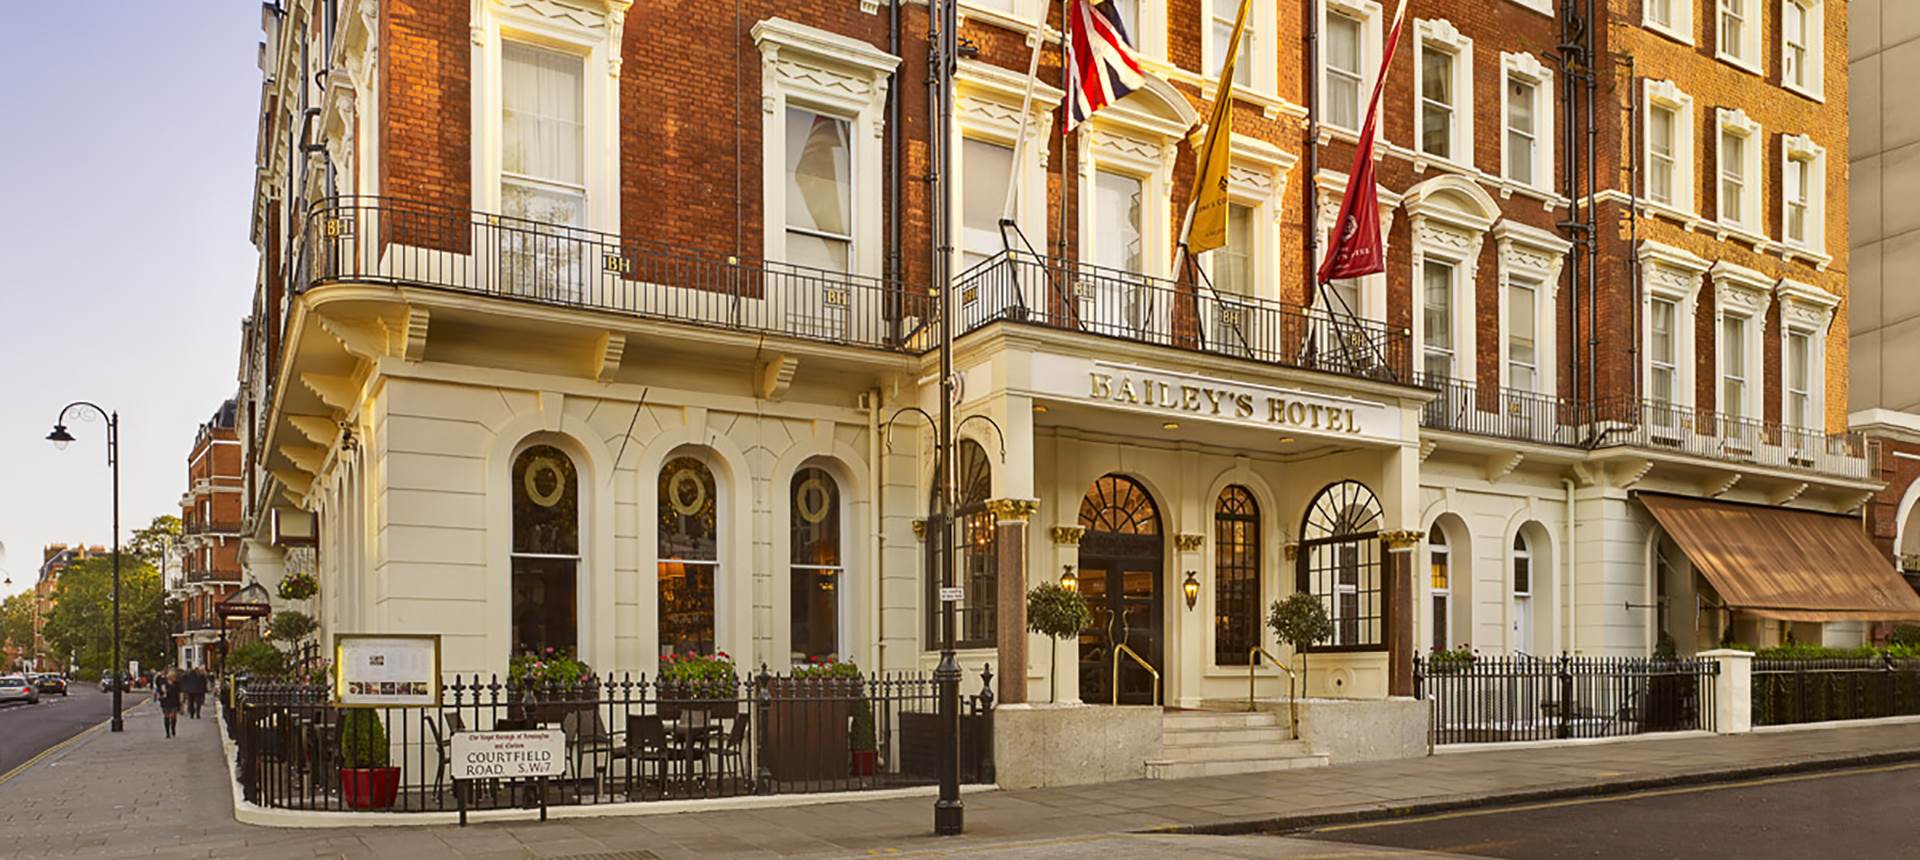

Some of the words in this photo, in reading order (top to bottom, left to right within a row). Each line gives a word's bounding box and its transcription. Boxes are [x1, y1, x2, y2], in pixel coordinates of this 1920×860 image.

[327, 220, 348, 236] BH
[608, 256, 630, 273] BH
[1074, 282, 1092, 297] BH
[828, 290, 847, 305] BH
[1223, 310, 1238, 325] BH
[1351, 334, 1366, 347] BH
[1089, 372, 1254, 418] BAILEY'S
[1267, 397, 1361, 434] HOTEL
[467, 751, 551, 763] COURTFIELD
